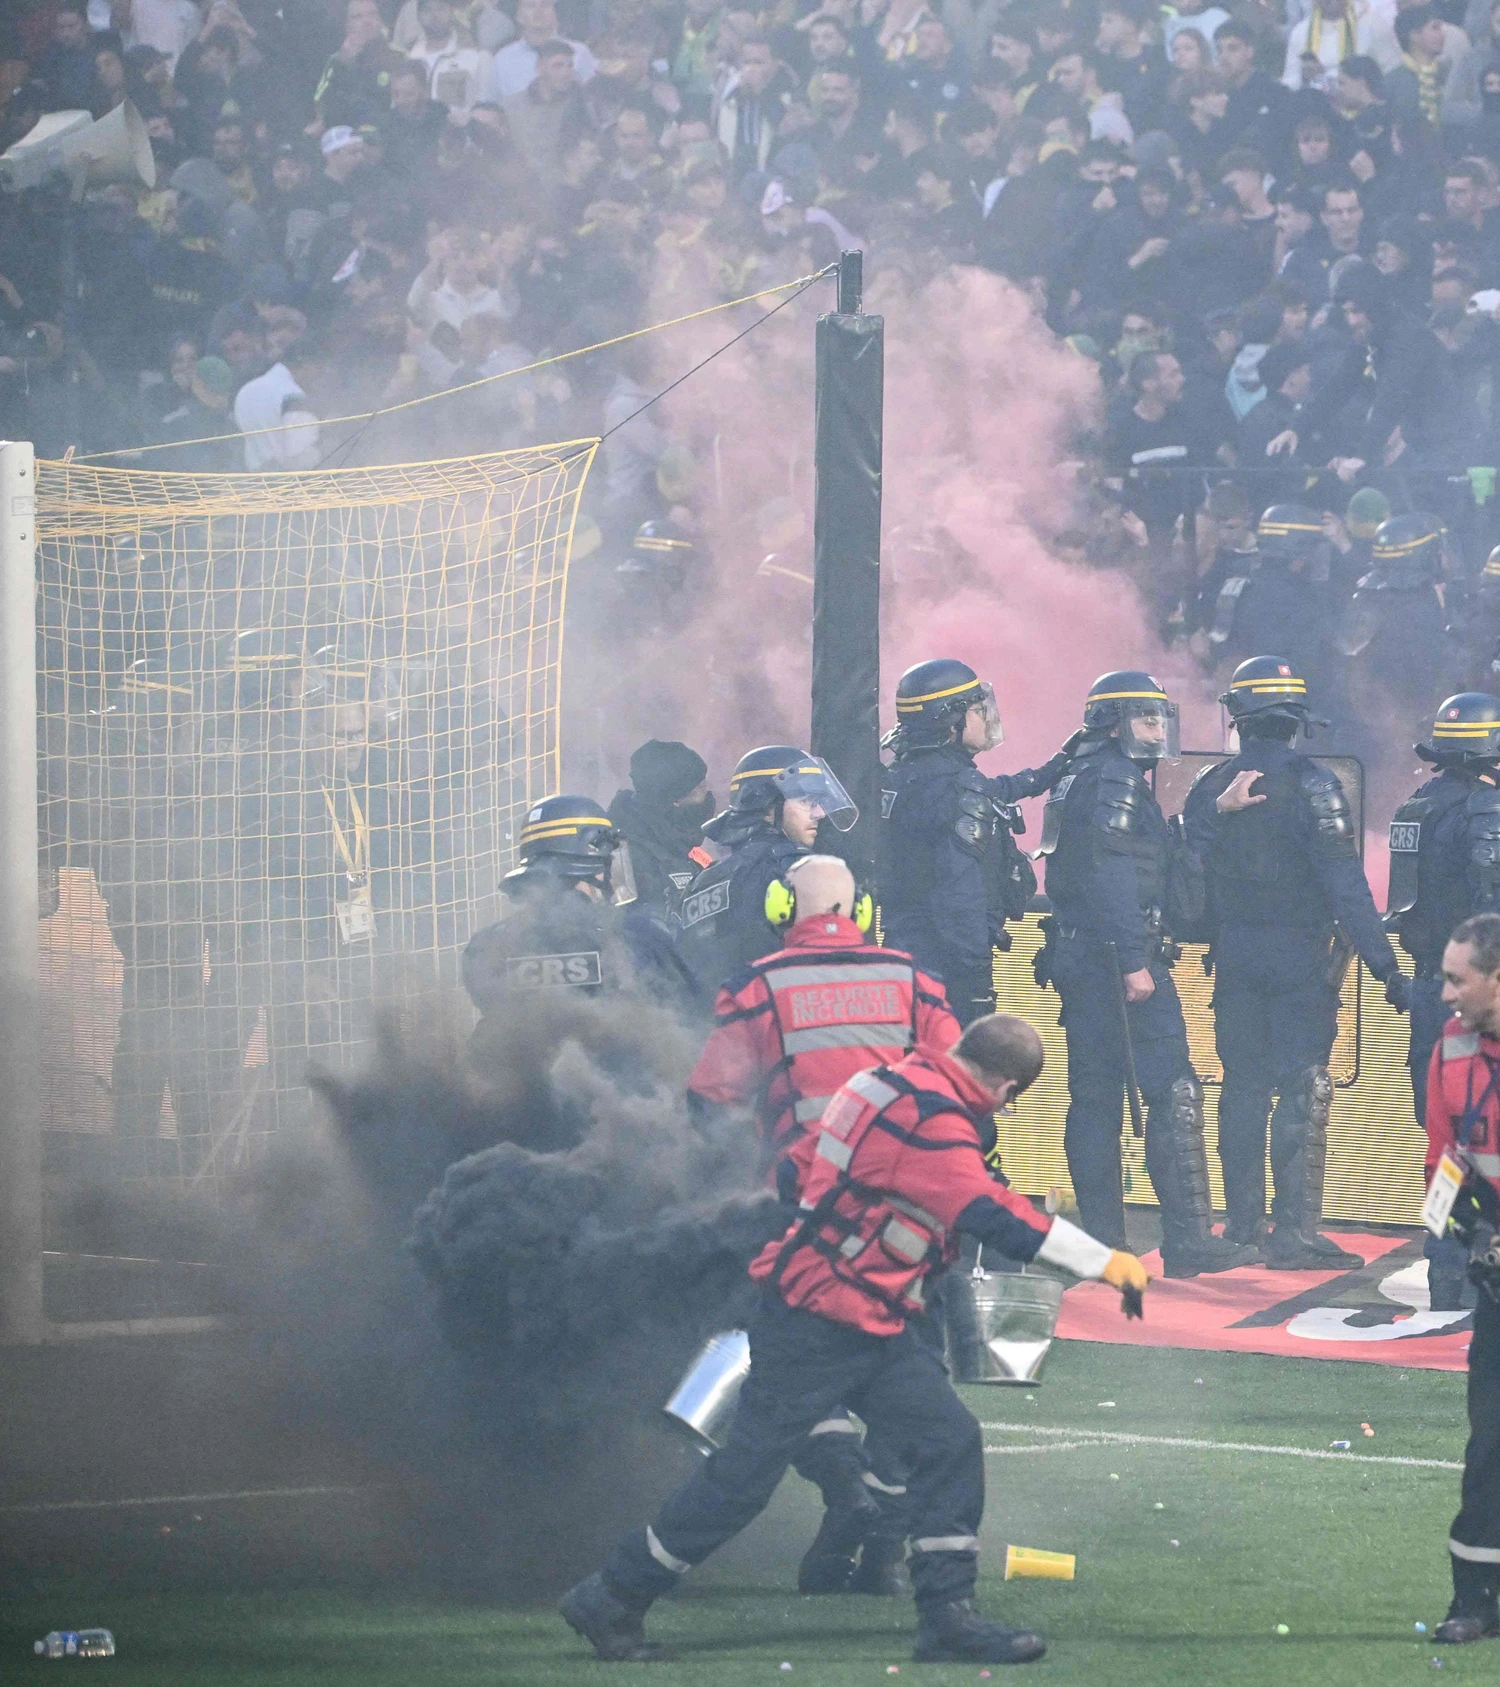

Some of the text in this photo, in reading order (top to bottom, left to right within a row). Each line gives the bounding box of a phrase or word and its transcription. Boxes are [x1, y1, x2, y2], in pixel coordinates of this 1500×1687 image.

[1391, 827, 1415, 848] CRS
[685, 886, 723, 923] CRS
[514, 956, 591, 985] CRS
[792, 1000, 901, 1024] INCENDIE
